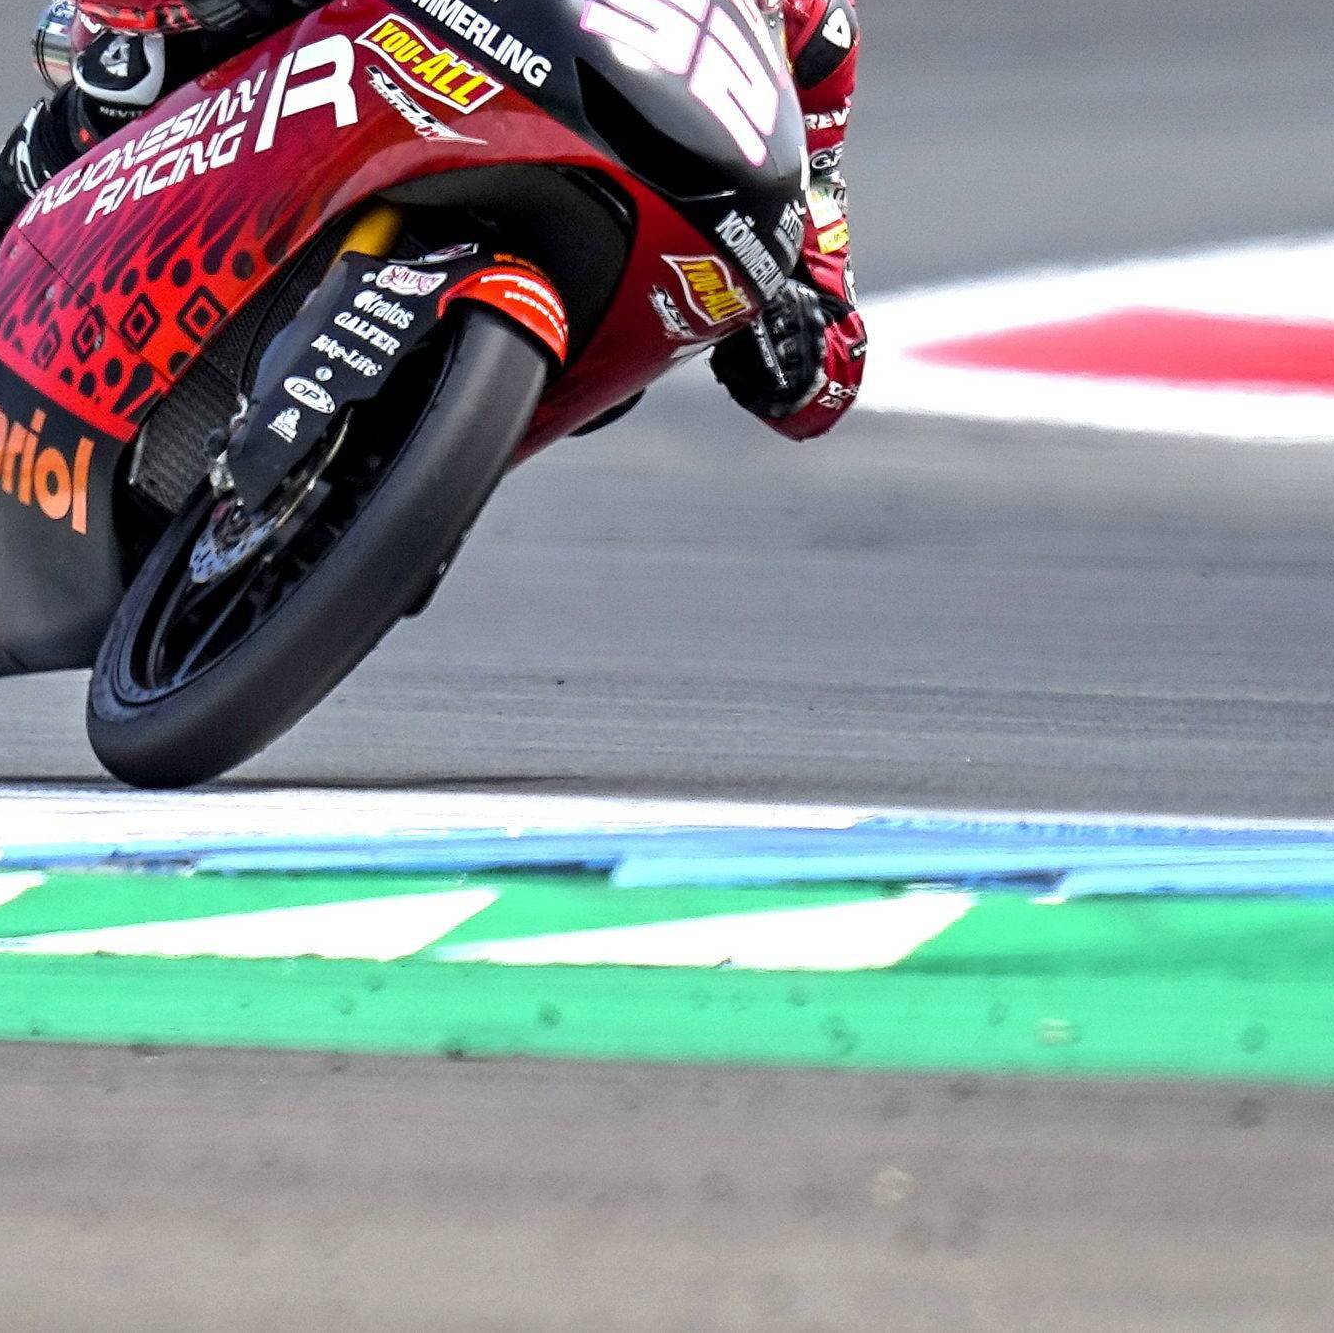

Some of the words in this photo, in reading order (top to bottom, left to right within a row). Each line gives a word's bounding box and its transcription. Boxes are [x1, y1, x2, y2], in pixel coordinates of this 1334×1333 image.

[371, 21, 470, 106] YOU-ALL
[18, 70, 267, 228] INDONESIAN
[84, 120, 247, 225] RACING
[334, 312, 401, 356] GALFER
